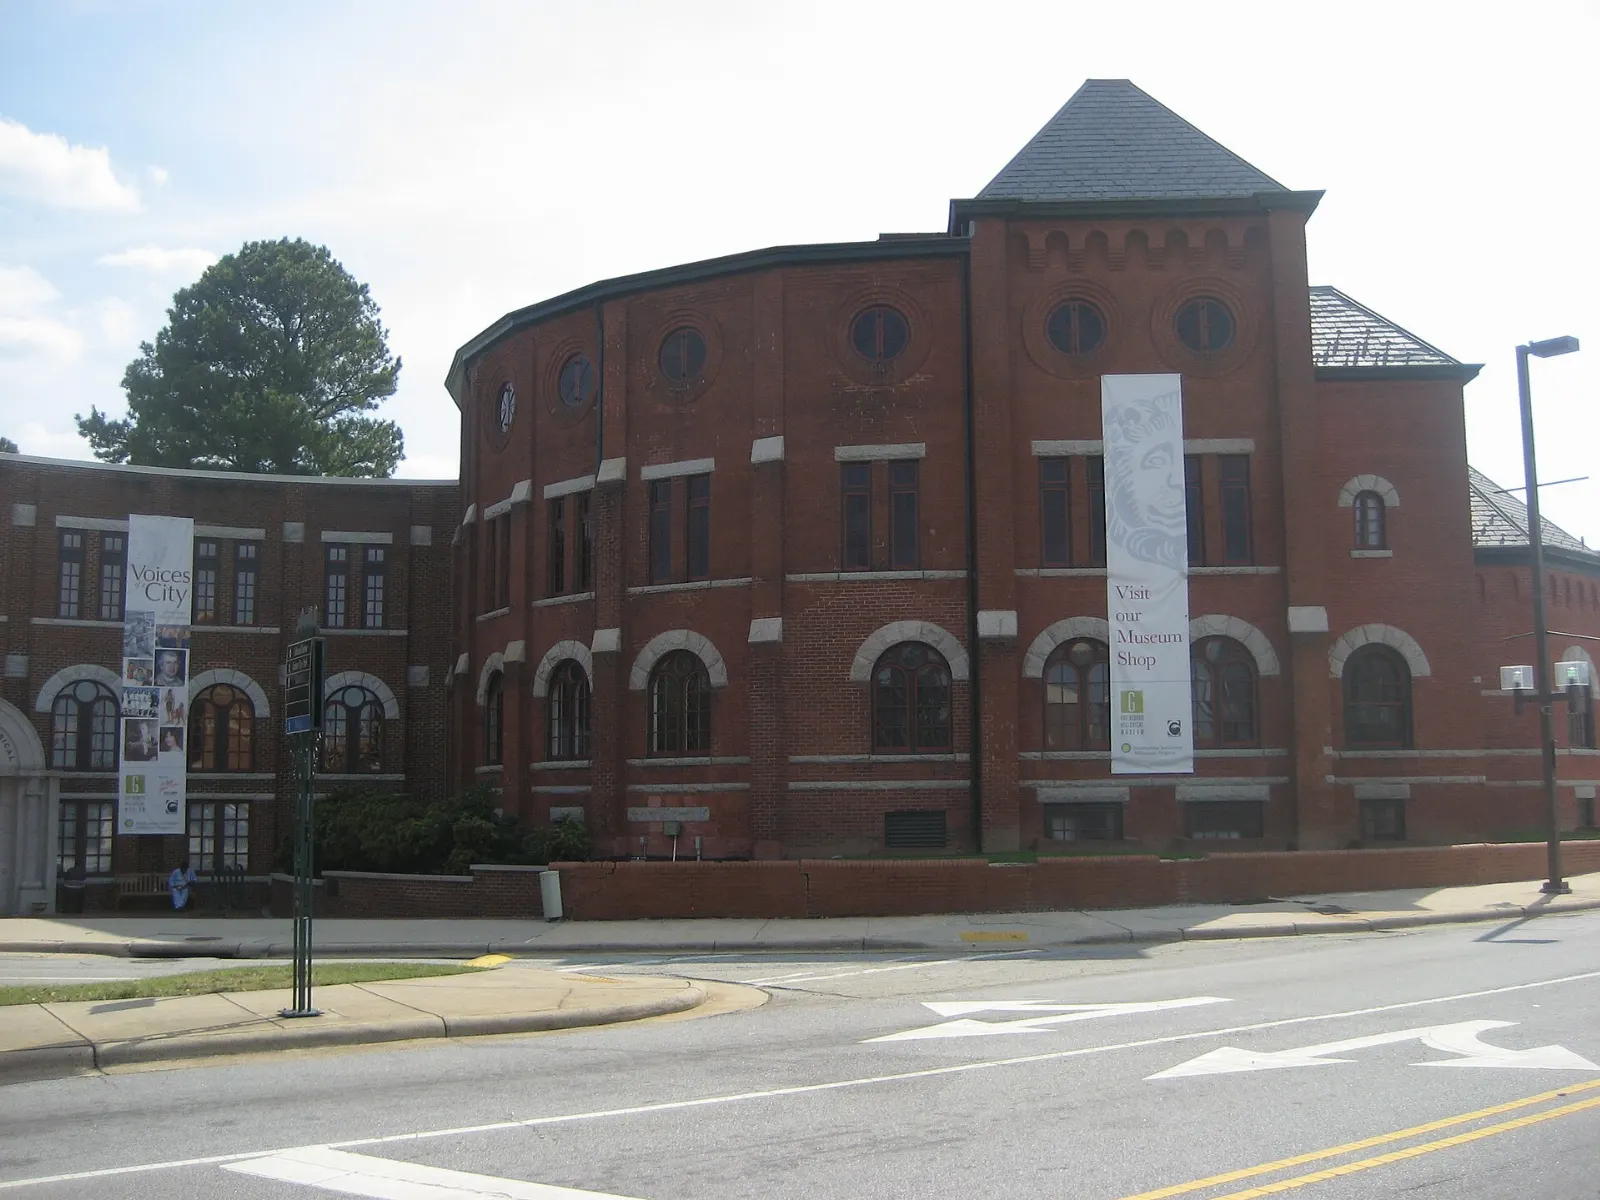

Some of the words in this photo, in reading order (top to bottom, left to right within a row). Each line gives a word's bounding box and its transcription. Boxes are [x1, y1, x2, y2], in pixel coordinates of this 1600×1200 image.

[131, 563, 191, 584] Voices
[145, 581, 188, 609] City
[1115, 585, 1151, 600] Visit
[1115, 612, 1142, 622] our
[1116, 629, 1183, 644] Museum
[1117, 651, 1156, 670] Shop
